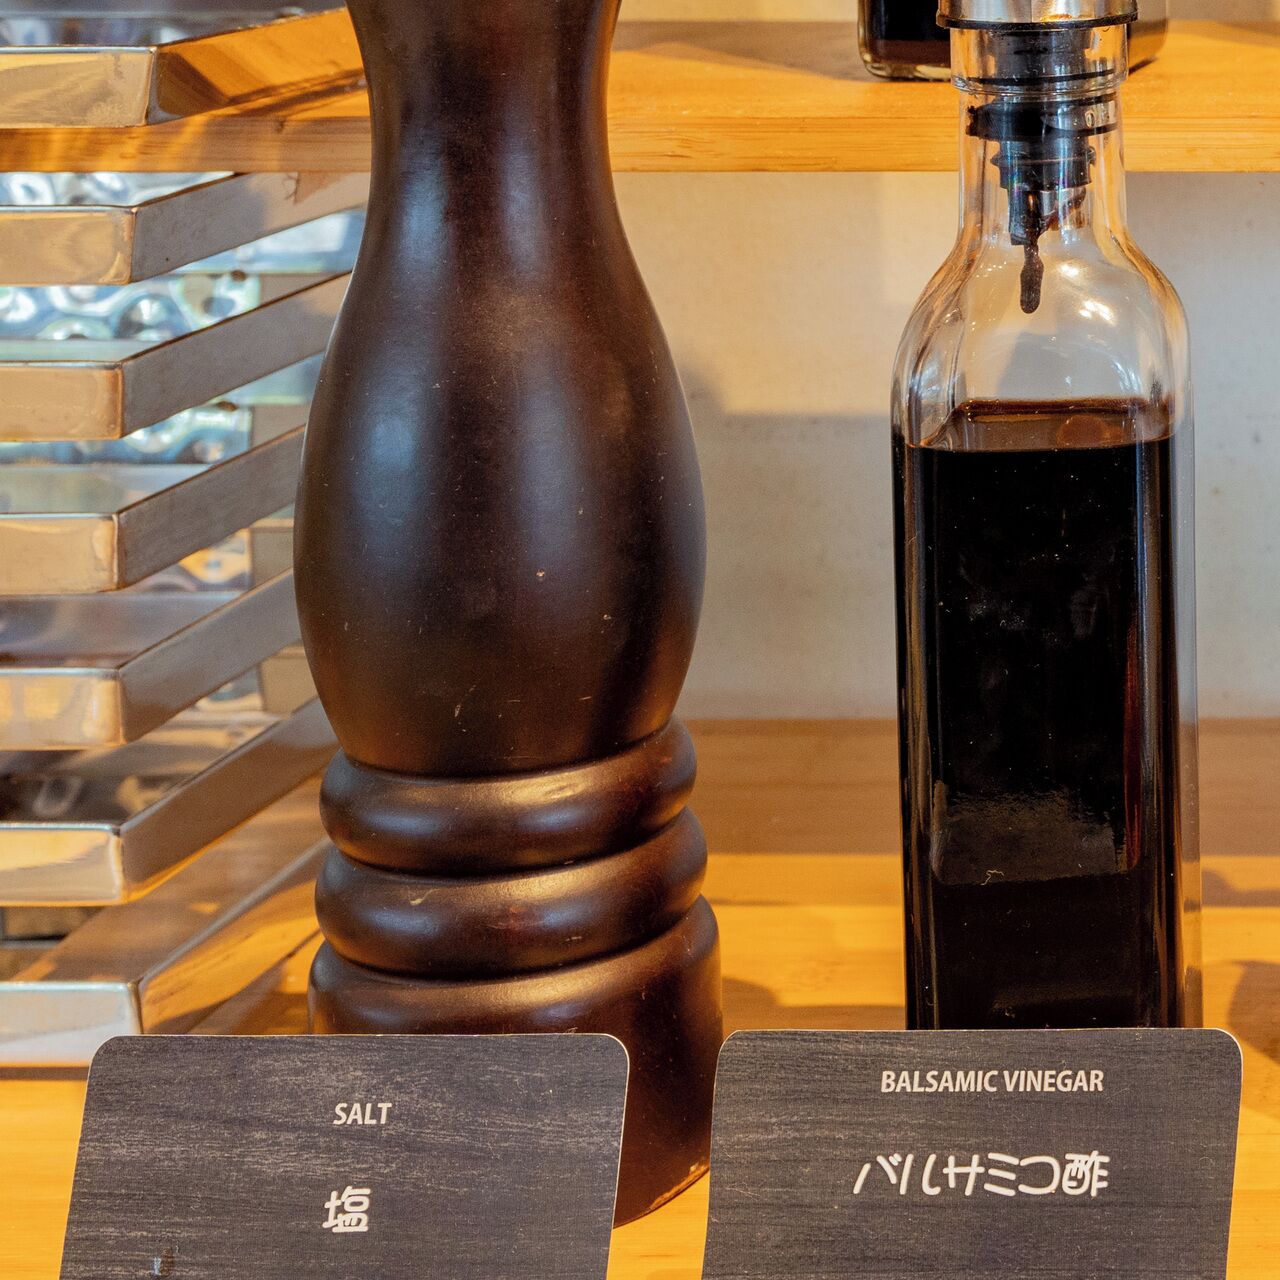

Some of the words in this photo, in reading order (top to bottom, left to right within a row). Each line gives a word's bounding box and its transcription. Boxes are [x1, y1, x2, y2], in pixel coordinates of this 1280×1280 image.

[881, 1070, 998, 1092] BALSAMIC
[1003, 1070, 1105, 1092] VINEGAR
[333, 1102, 393, 1125] SALT
[852, 1150, 1110, 1197] バルサミコ酢
[322, 1185, 372, 1233] 塩
